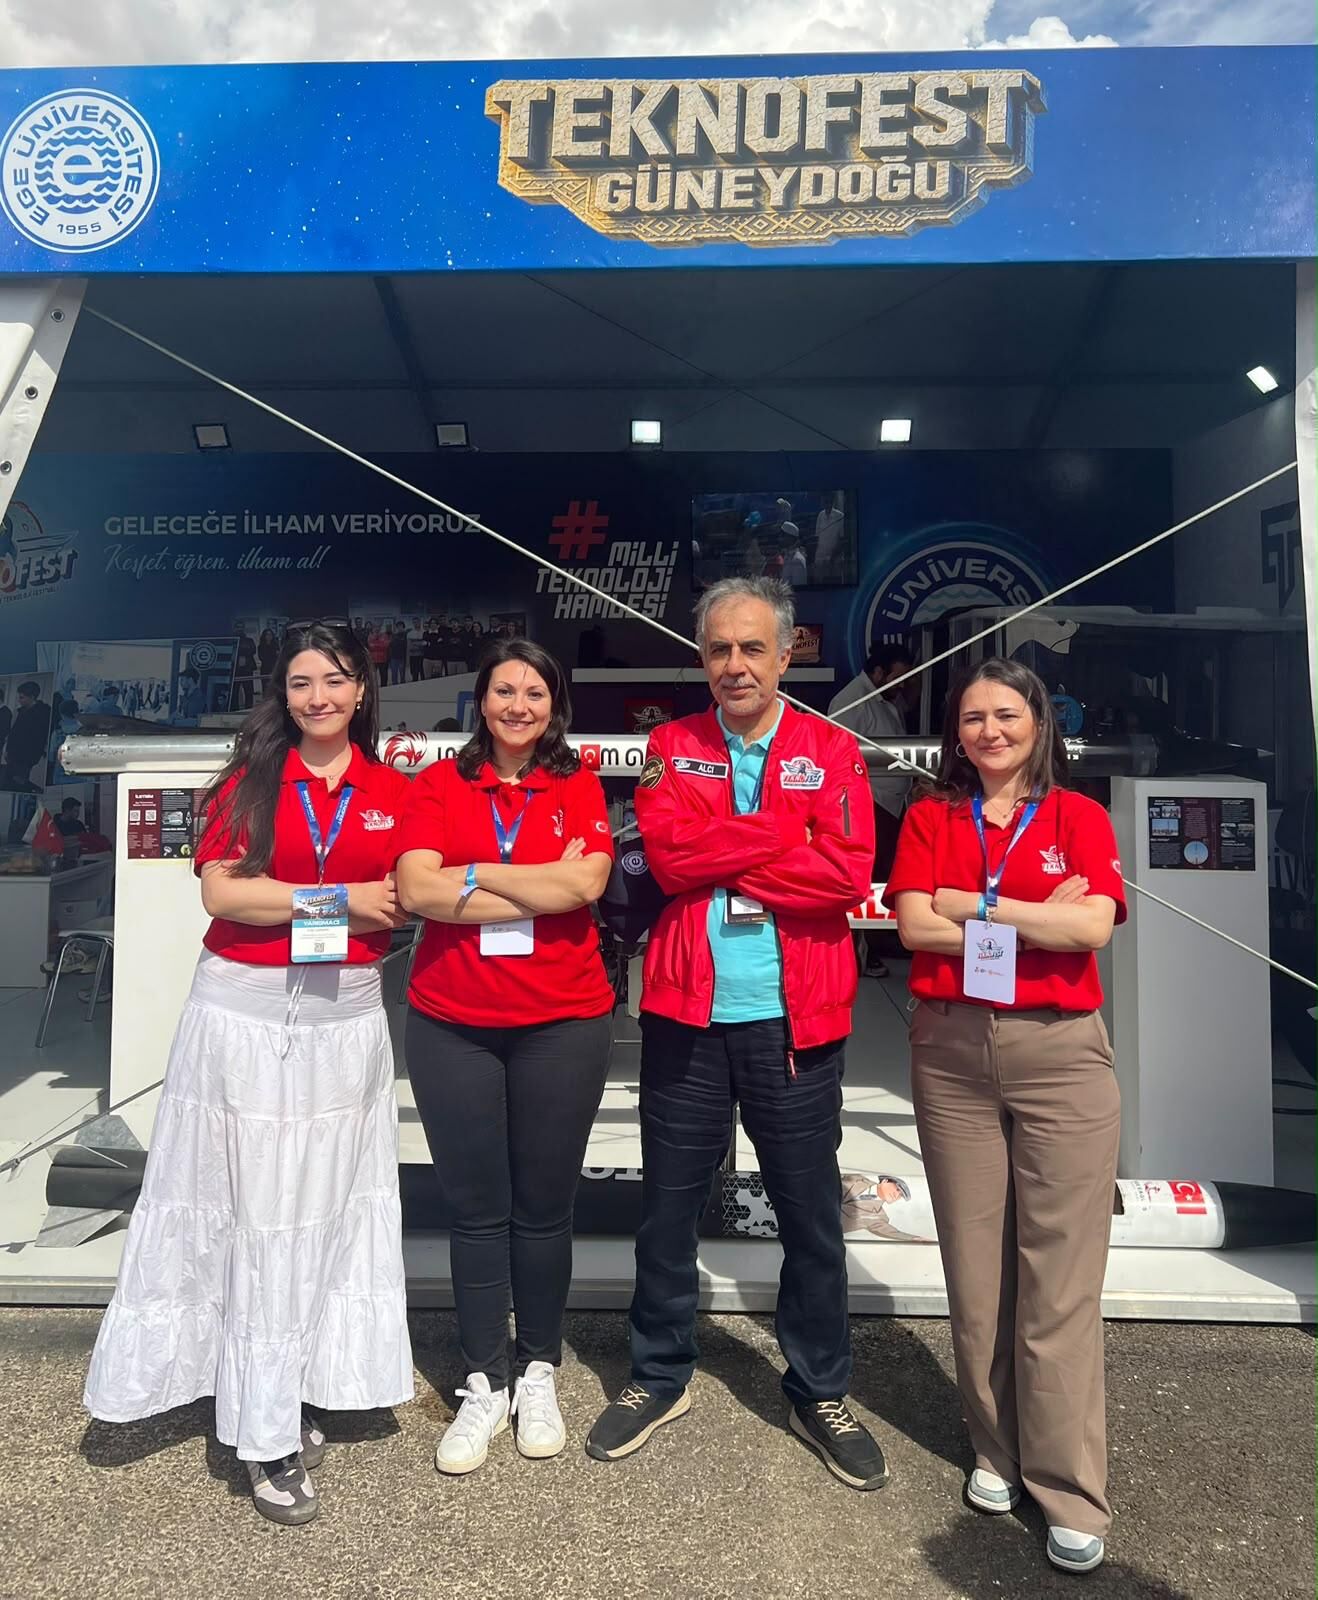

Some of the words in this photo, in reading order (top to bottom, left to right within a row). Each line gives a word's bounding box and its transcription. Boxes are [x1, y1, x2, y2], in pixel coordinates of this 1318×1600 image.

[492, 70, 1032, 163] TEKNOFEST
[13, 104, 144, 226] ÜNİVERSİTESİ
[594, 156, 955, 214] GÜNEYDOĞU
[13, 167, 49, 226] EGE
[56, 220, 103, 236] 1955
[104, 510, 237, 535] GELECEĞE
[243, 509, 324, 534] İLHAM
[332, 508, 481, 534] VERİYORUZ
[237, 545, 293, 571] ilham
[296, 545, 332, 570] al!
